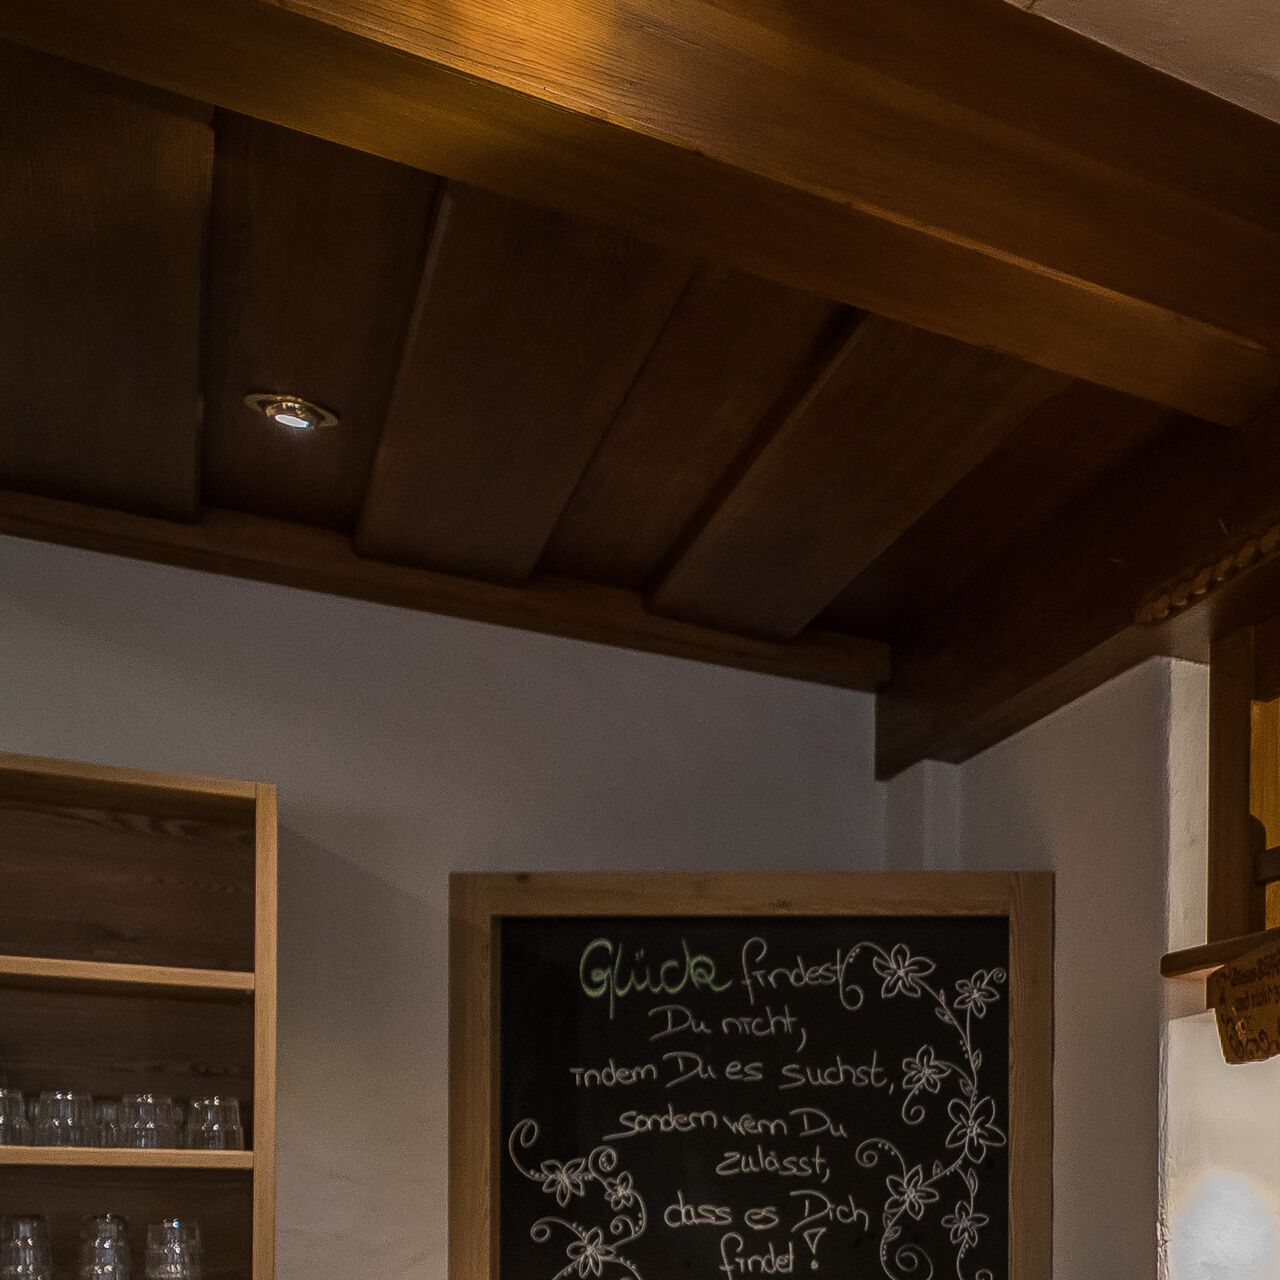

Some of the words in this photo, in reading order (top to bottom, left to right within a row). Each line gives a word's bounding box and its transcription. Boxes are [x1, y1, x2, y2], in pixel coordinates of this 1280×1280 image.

[580, 939, 732, 1019] Glück
[742, 937, 848, 1005] findest
[648, 1005, 712, 1041] Du
[722, 1005, 806, 1052] nicht,
[569, 1056, 657, 1088] indem
[663, 1052, 716, 1089] Du
[725, 1061, 764, 1082] es
[779, 1051, 895, 1096] suchst,
[602, 1104, 717, 1141] sondern
[789, 1107, 848, 1138] Du
[664, 1190, 732, 1228] dass
[744, 1206, 779, 1231] es
[789, 1190, 869, 1232] Dich
